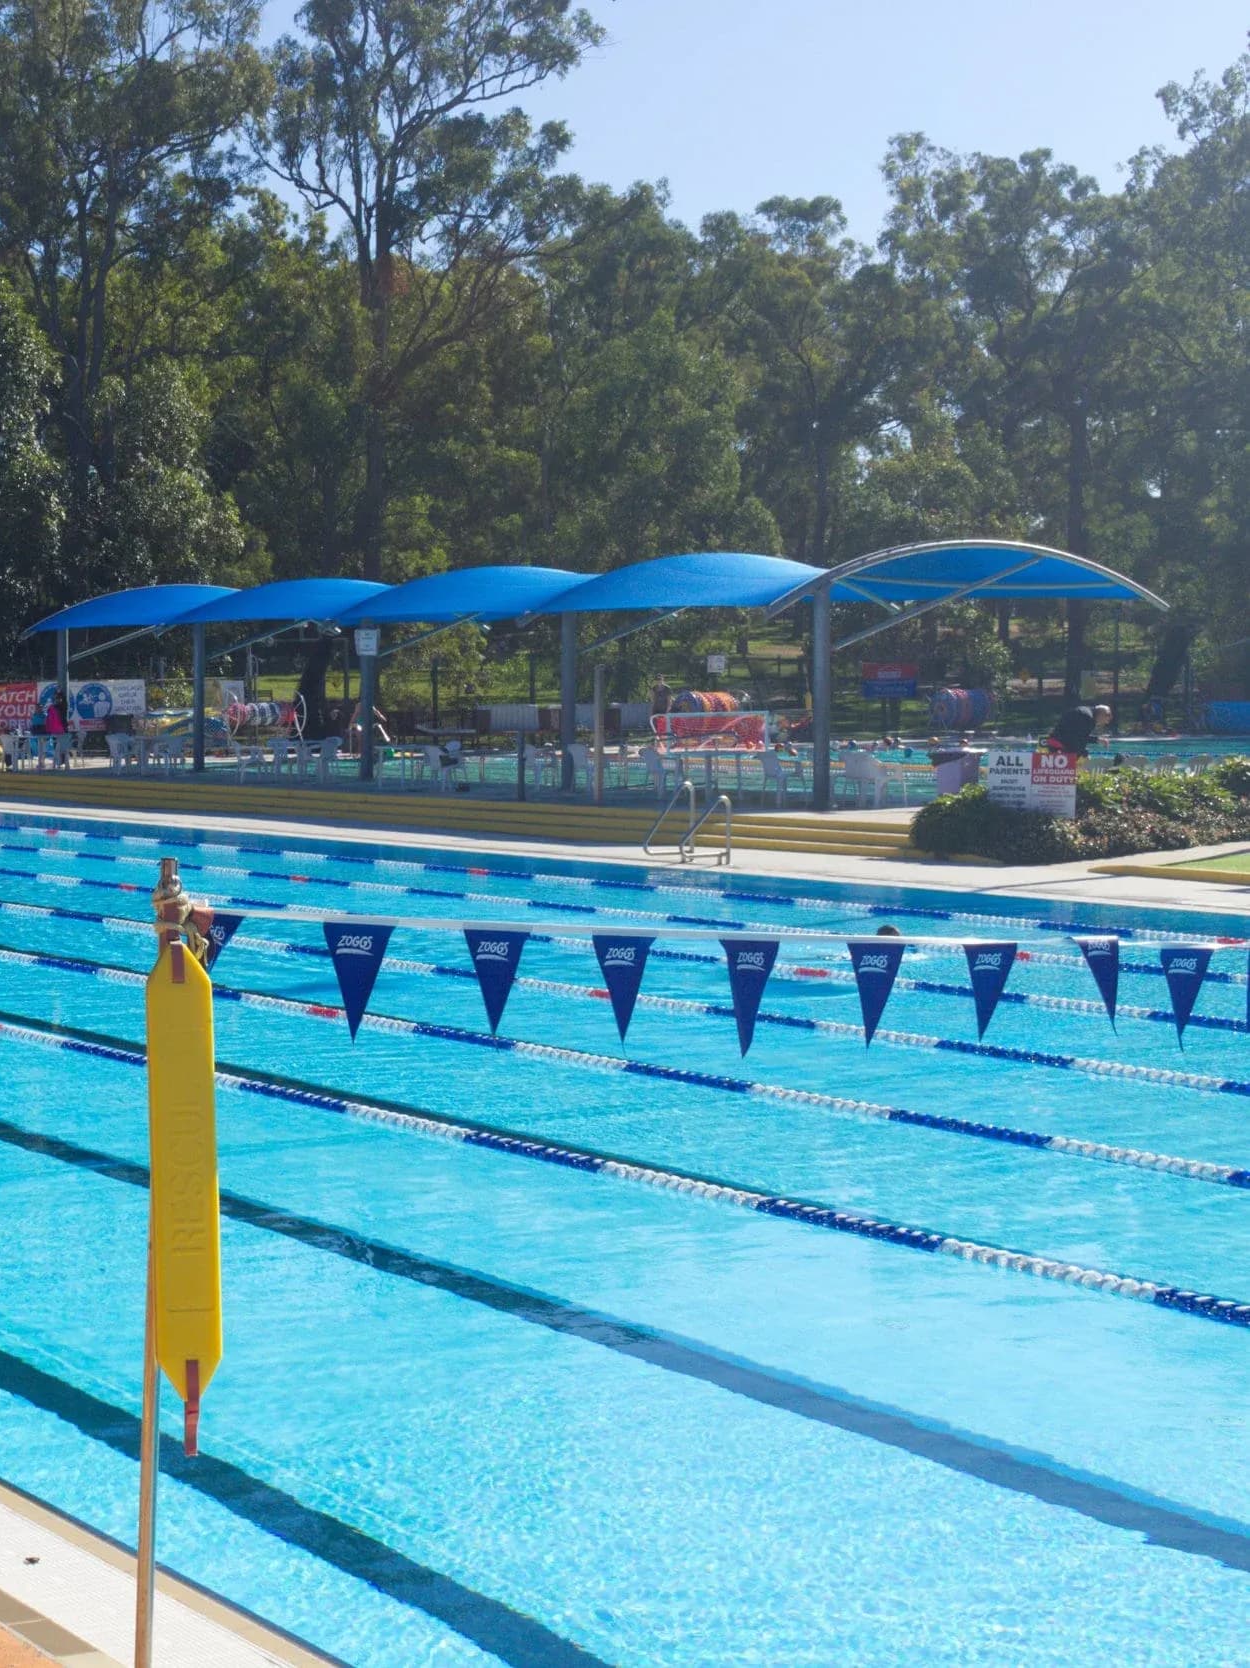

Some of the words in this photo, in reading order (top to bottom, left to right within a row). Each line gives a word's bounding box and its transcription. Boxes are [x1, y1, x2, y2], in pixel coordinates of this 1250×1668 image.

[996, 755, 1024, 767] ALL
[1041, 754, 1068, 769] NO
[1033, 775, 1047, 783] ON
[337, 935, 373, 950] ZOGGS
[477, 941, 508, 956] ZOGGS
[606, 947, 636, 961] ZOGGS
[737, 951, 765, 966] ZOGGS
[860, 954, 888, 967] ZOGGS
[975, 953, 1001, 966] ZOGGS
[1169, 958, 1197, 969] ZOGGS
